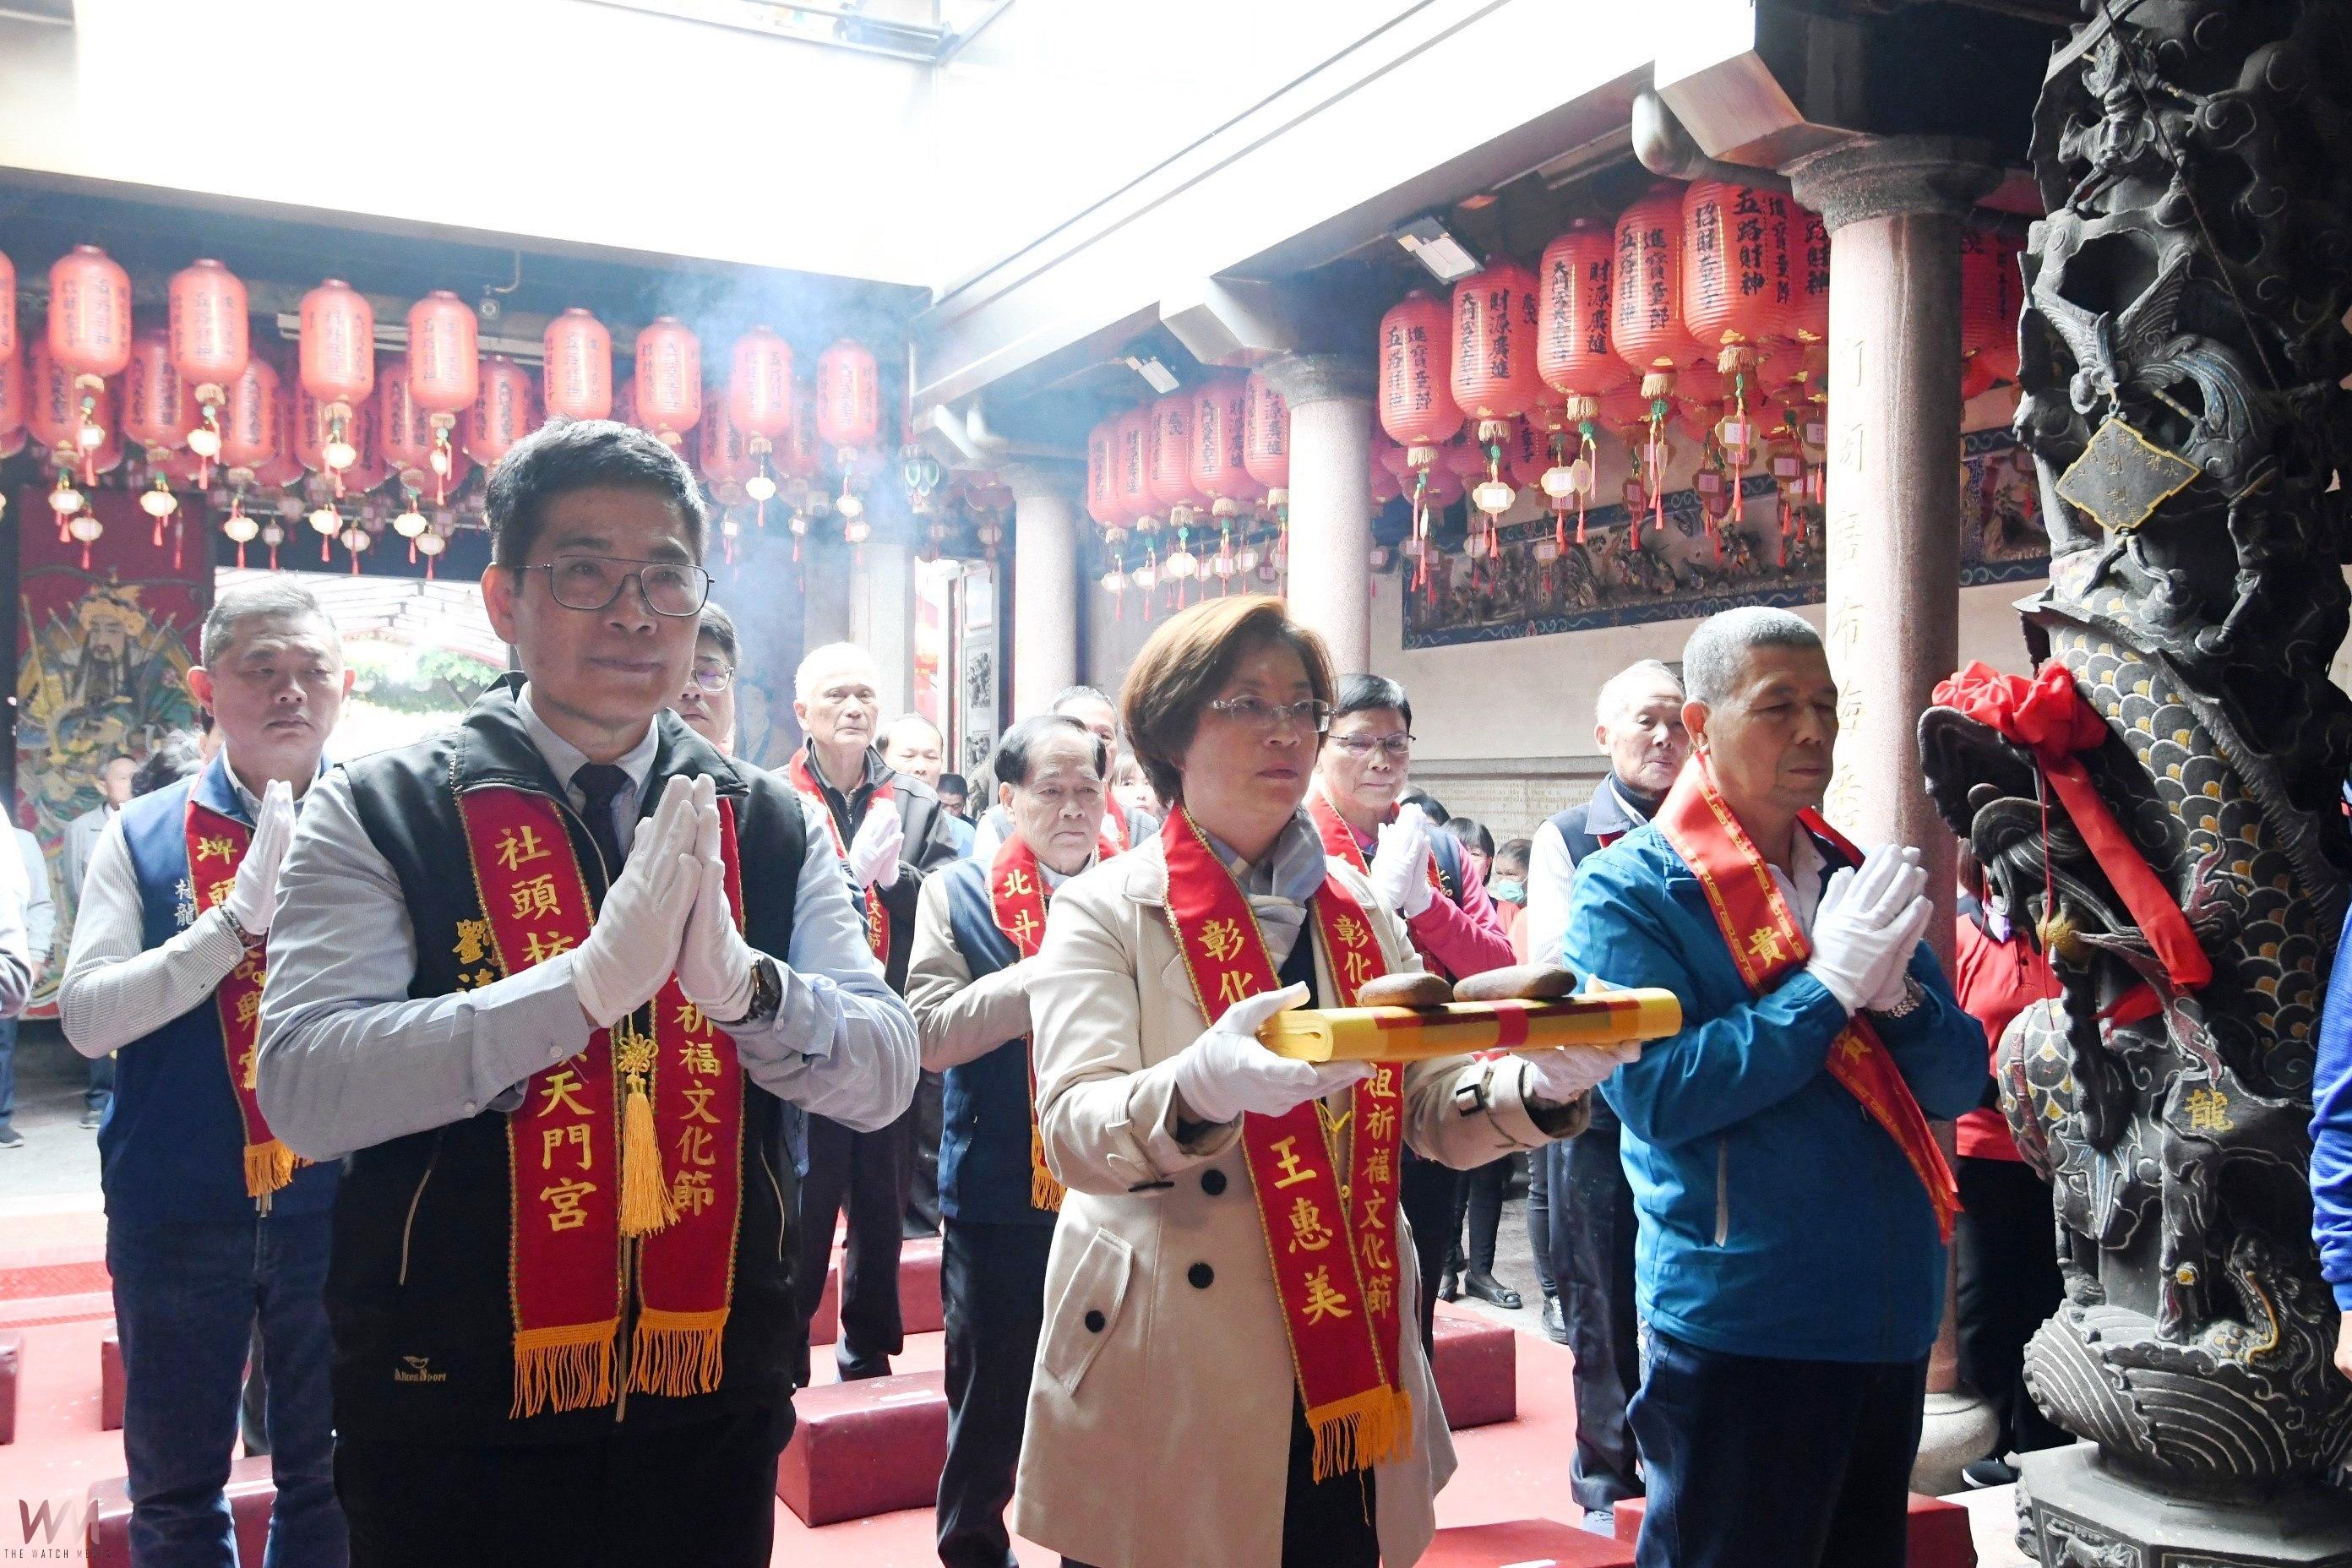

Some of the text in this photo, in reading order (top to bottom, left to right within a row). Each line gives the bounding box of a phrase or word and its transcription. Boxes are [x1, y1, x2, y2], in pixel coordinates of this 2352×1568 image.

[1733, 188, 1765, 296] 五路財神
[1805, 220, 1831, 295] 路財神
[1487, 288, 1512, 379] 財源廣進
[1586, 258, 1612, 354] 財源廣進
[1003, 868, 1040, 942] 北斗
[1747, 927, 1786, 968] 貴
[537, 1070, 597, 1232] 天門宮
[1197, 917, 1353, 1326] 彰化 王惠美
[1332, 914, 1397, 1319] 彰化 祖祈福文化節
[2184, 1087, 2235, 1132] 龍
